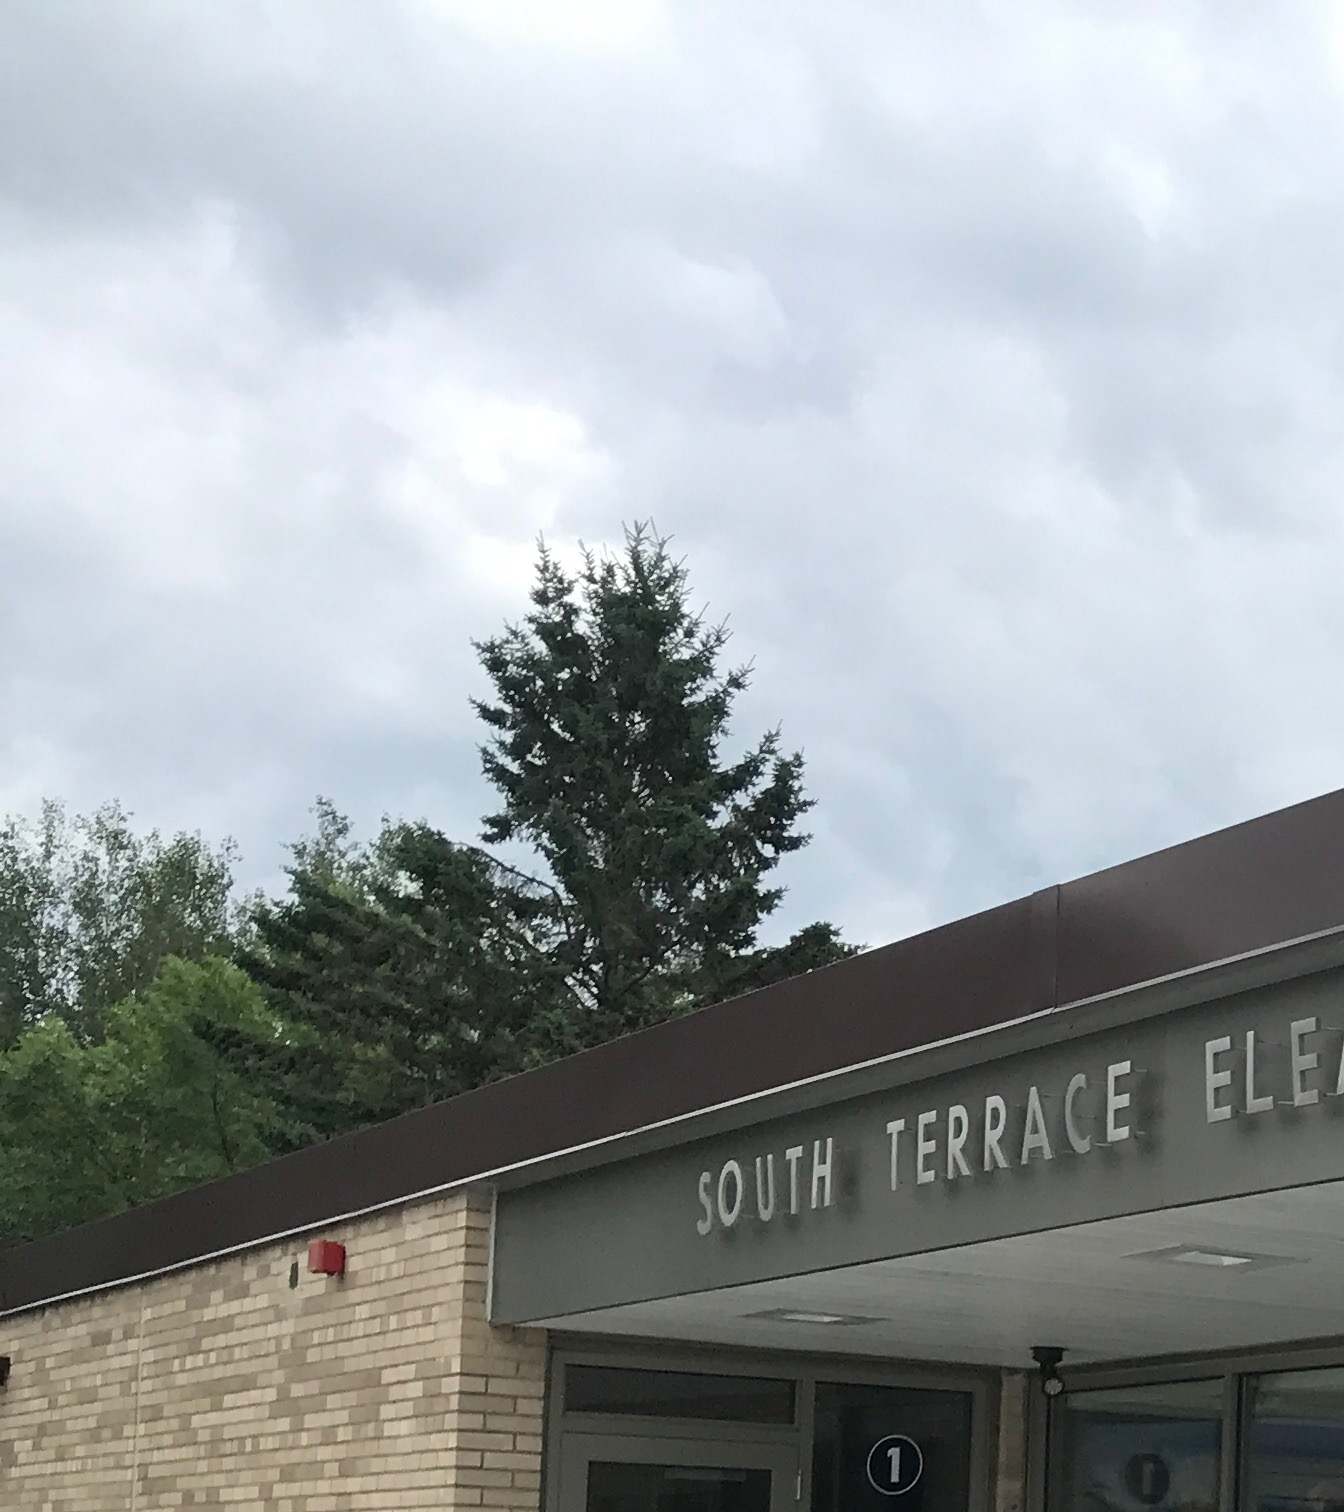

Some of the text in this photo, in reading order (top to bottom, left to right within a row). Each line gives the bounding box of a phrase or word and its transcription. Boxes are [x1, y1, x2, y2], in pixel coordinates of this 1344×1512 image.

[697, 1136, 835, 1236] SOUTH
[887, 1060, 1133, 1192] TERRACE
[886, 1446, 901, 1484] 1
